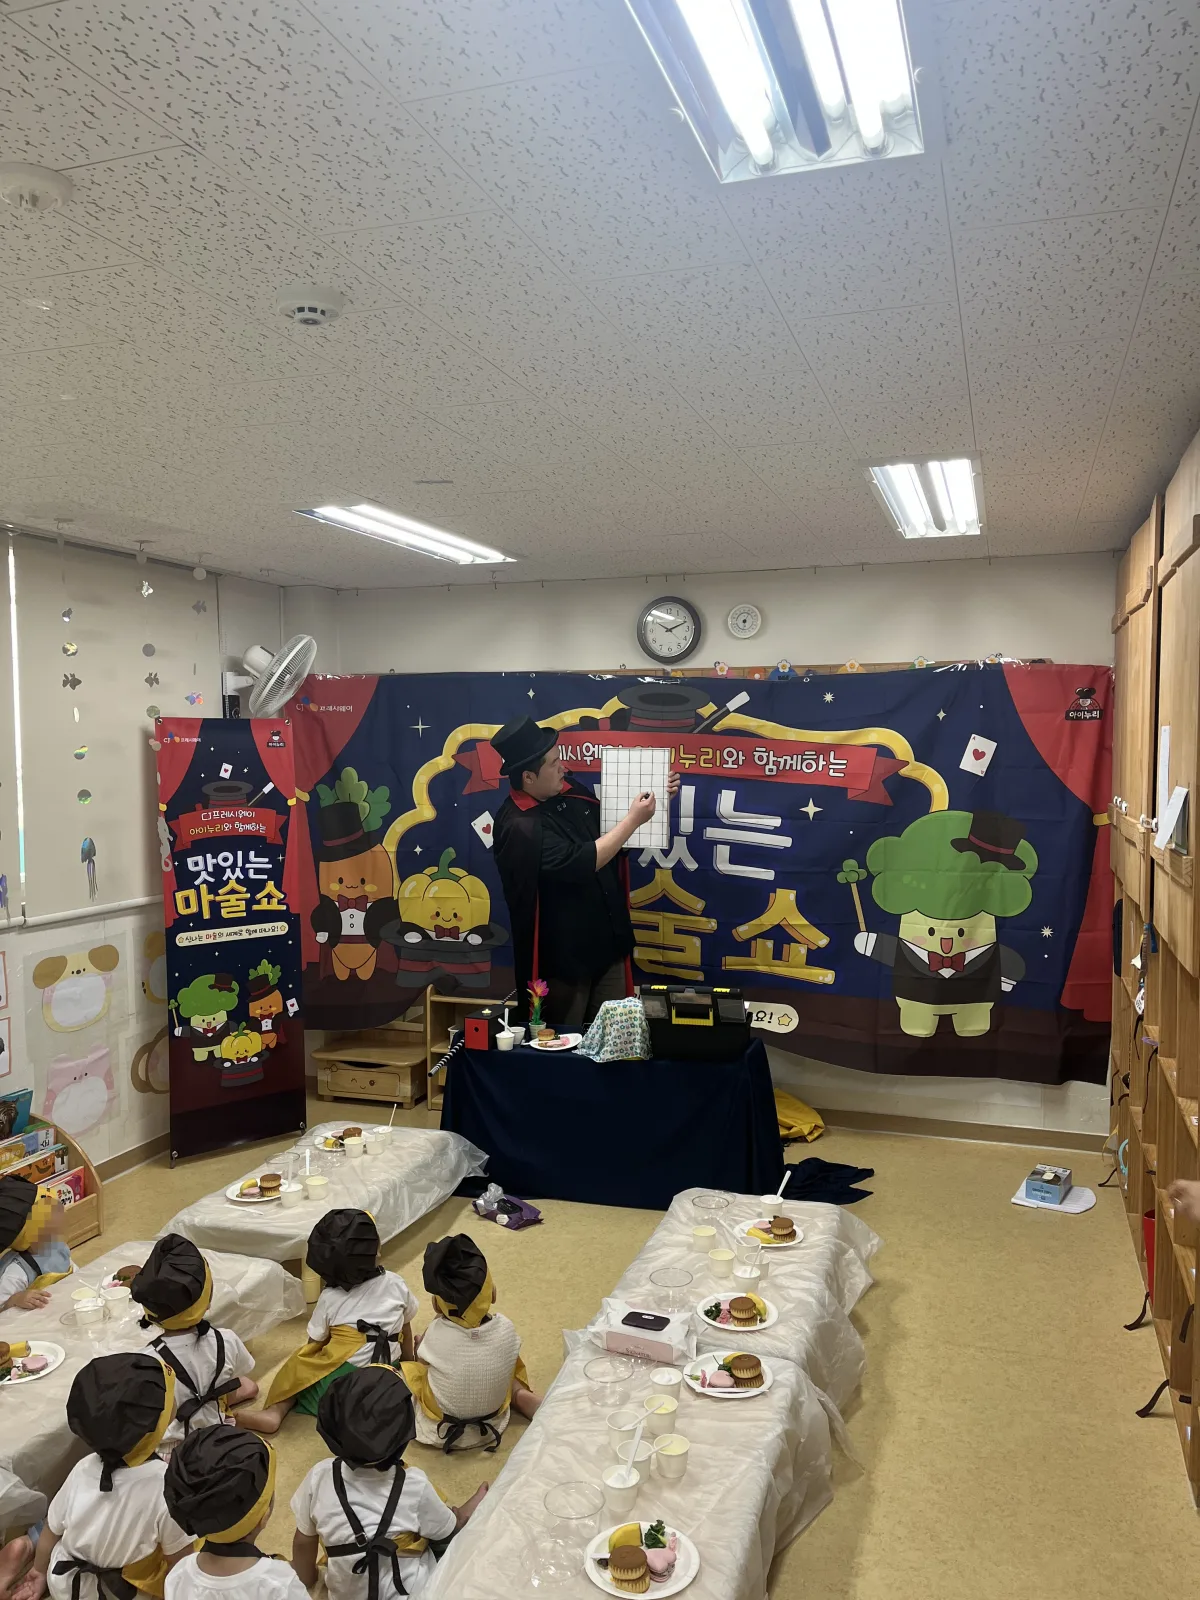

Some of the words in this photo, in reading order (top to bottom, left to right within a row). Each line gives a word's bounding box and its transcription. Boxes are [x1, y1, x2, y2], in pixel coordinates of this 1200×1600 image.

[1069, 710, 1100, 719] 아이누리
[752, 743, 849, 777] 함께하는
[189, 822, 233, 836] 아이누리와
[234, 821, 267, 834] 함께하는
[187, 850, 273, 886] 맛있는
